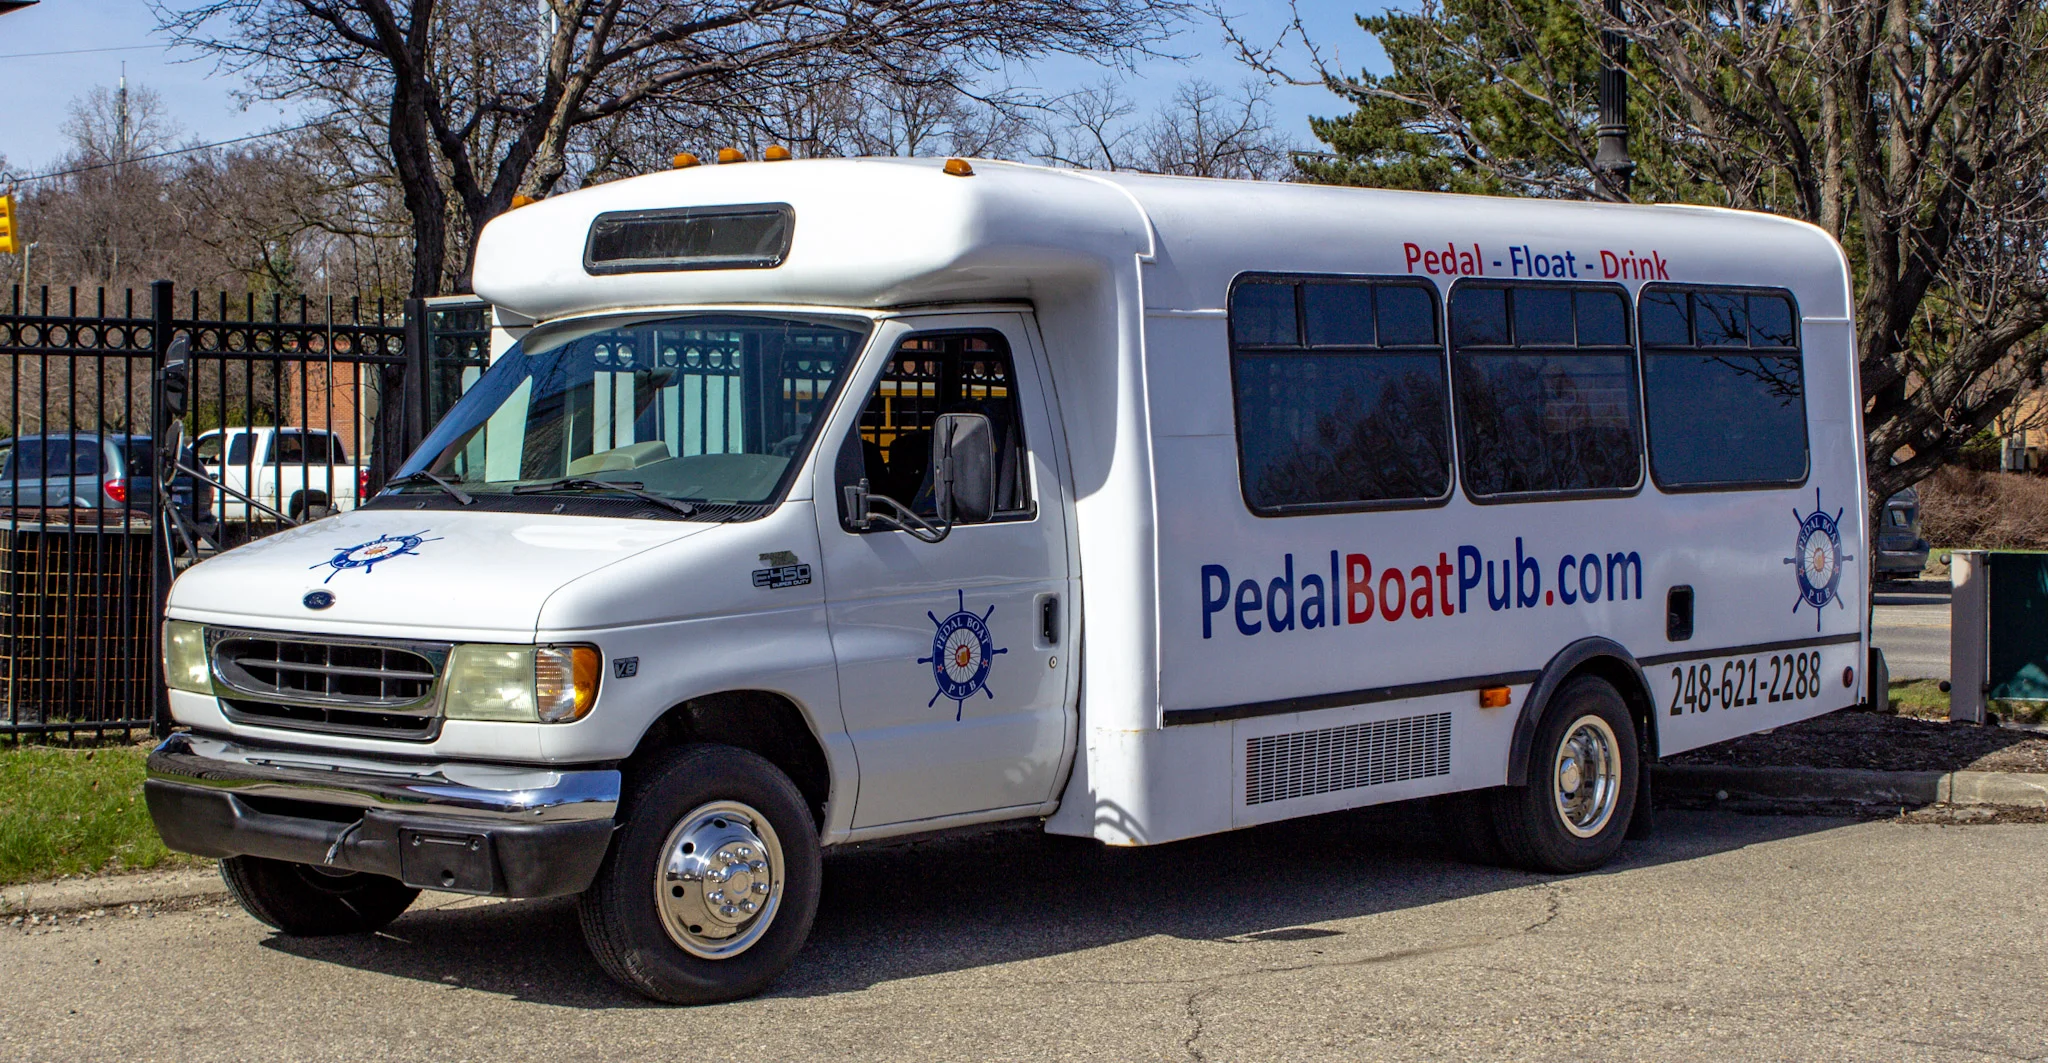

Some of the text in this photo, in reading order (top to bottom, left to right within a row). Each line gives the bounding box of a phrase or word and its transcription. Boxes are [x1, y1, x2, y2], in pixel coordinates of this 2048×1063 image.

[1403, 242, 1484, 276] Pedal
[1509, 245, 1578, 278] Float
[1600, 250, 1670, 281] Drink
[1798, 517, 1840, 550] PEDAL BOAT
[793, 578, 809, 586] DUTY
[1200, 536, 1643, 640] PedalBoatPub.com
[1808, 587, 1831, 604] PUB
[936, 617, 989, 650] PEDAL BOAT
[614, 662, 637, 678] V8
[1670, 651, 1821, 716] 248-621-2288
[948, 680, 977, 696] PUB
